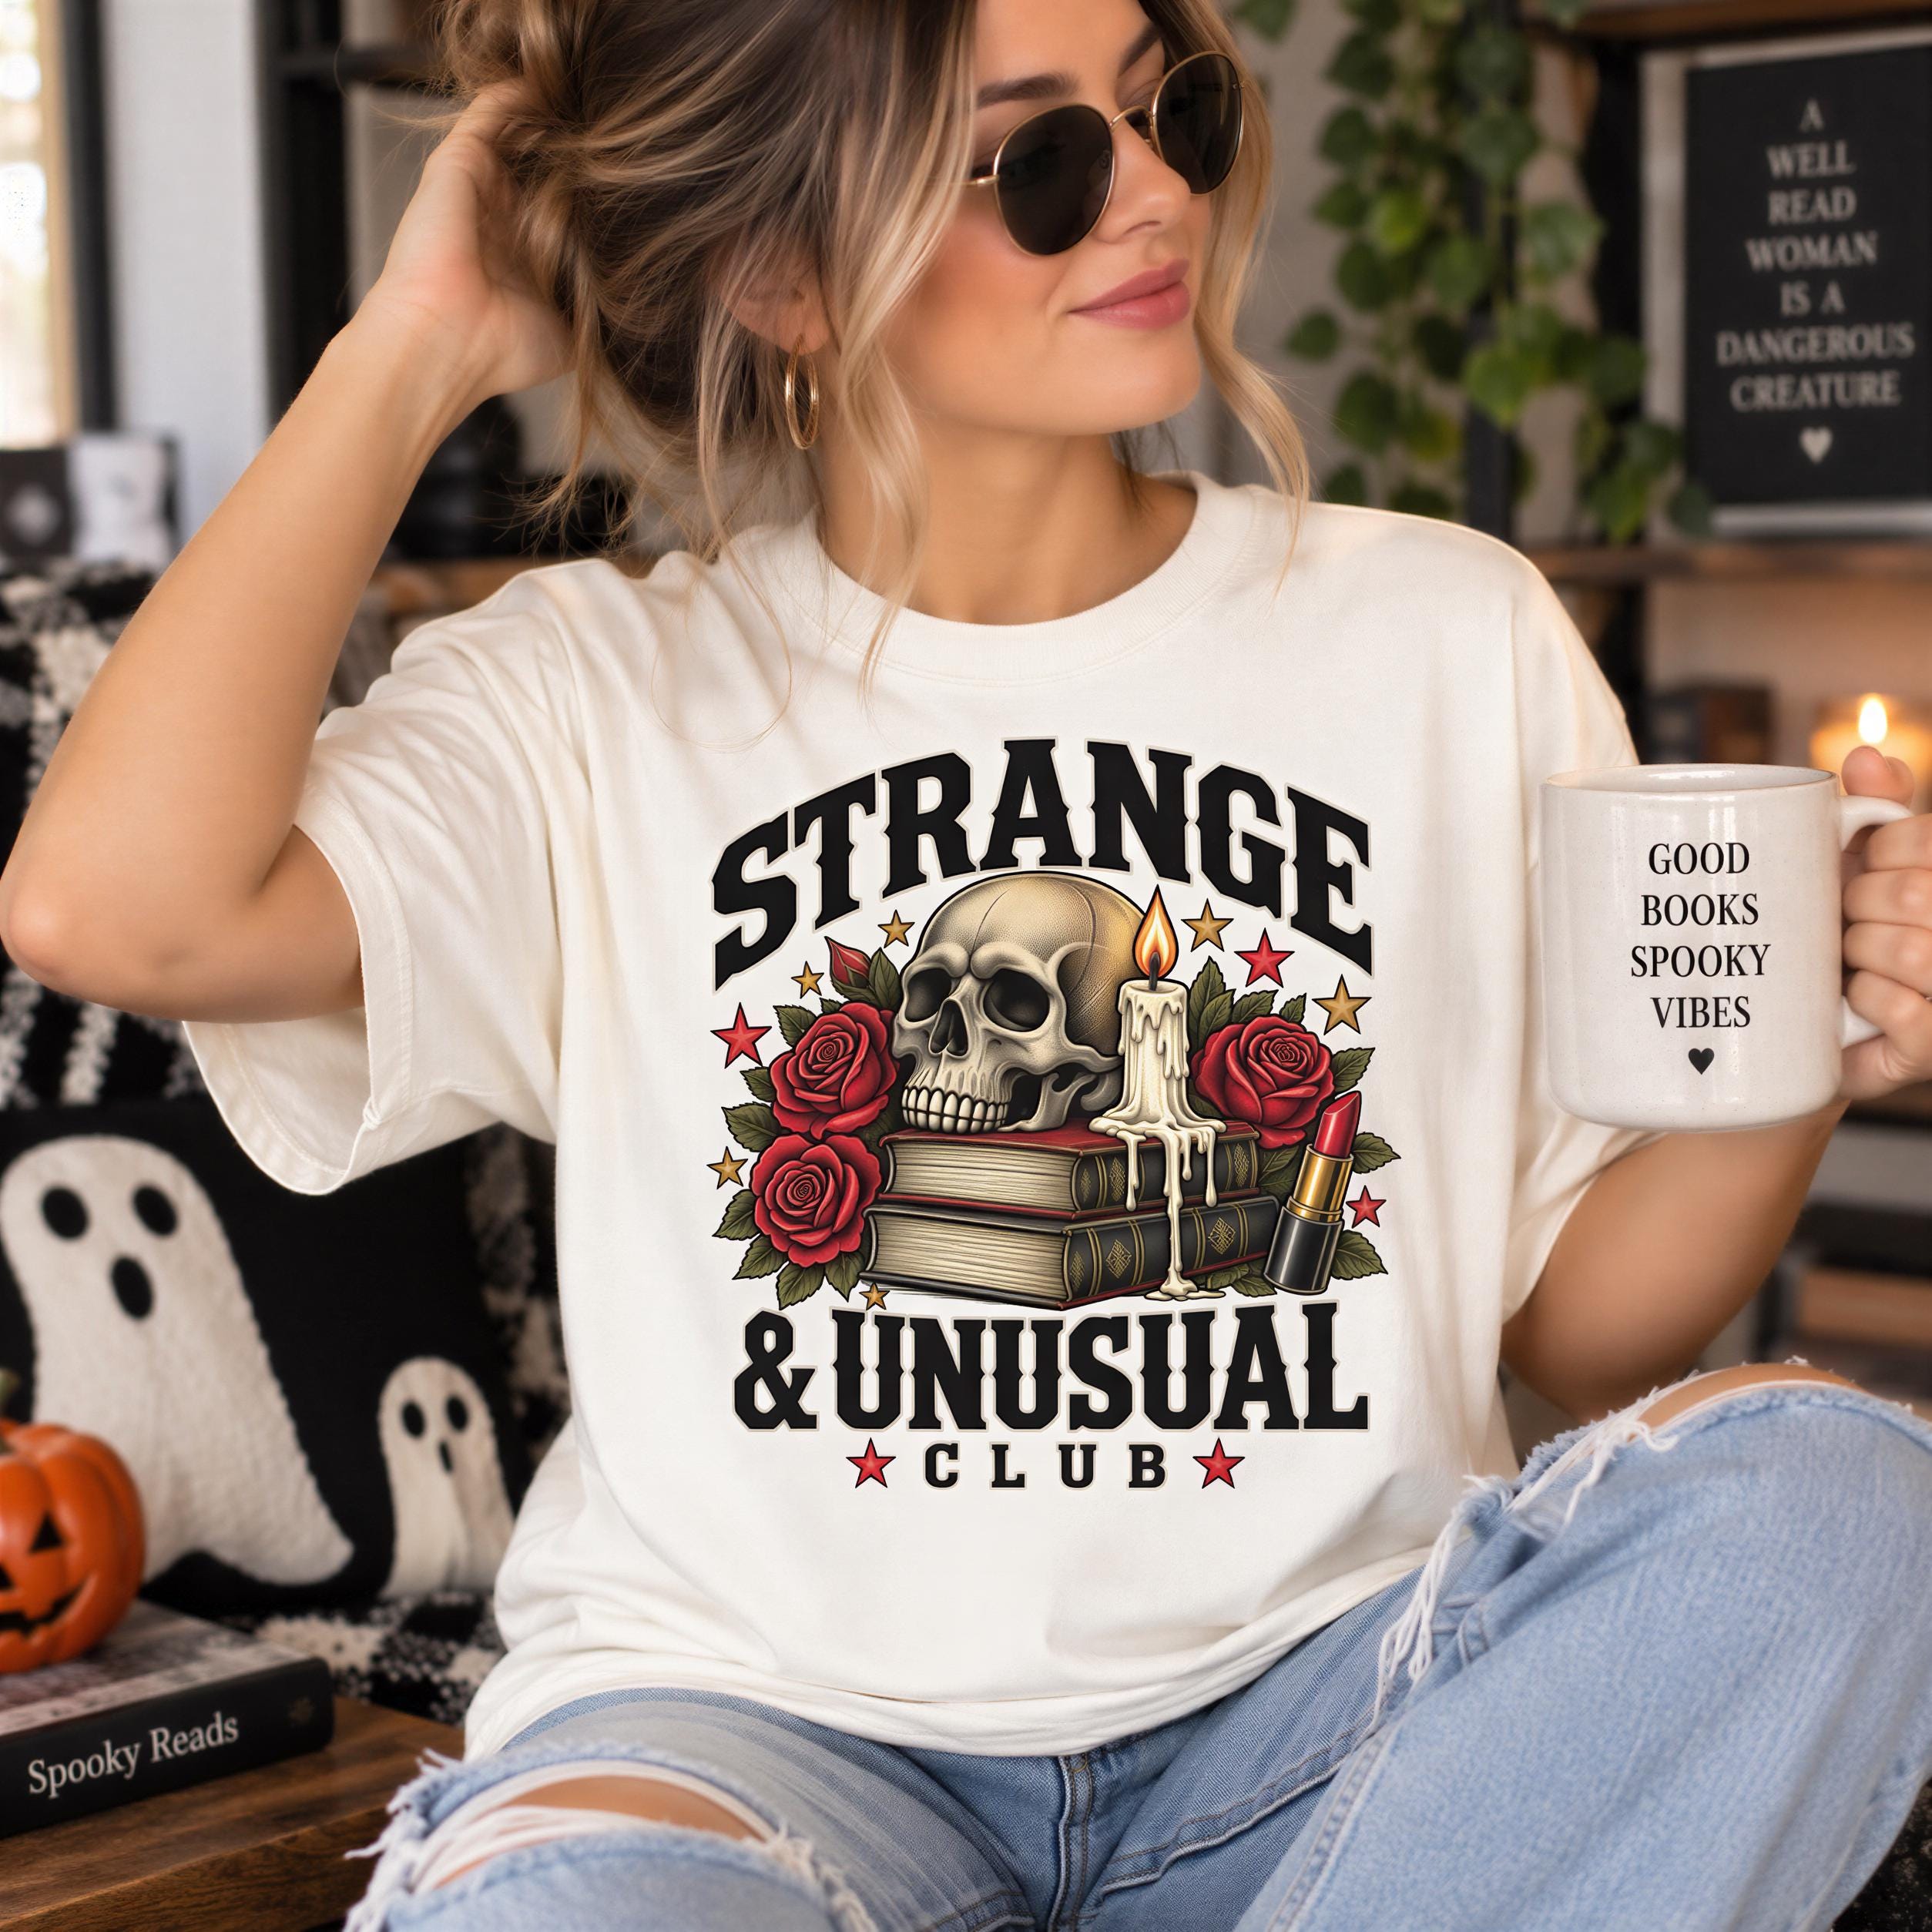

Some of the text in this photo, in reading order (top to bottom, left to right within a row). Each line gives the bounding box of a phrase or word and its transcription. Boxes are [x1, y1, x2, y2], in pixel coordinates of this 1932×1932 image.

[1801, 100, 1823, 131] A
[1767, 140, 1855, 179] WELL
[1768, 186, 1857, 225] READ
[1746, 230, 1877, 271] WOMAN
[1781, 281, 1845, 316] IS A
[1716, 322, 1915, 366] DANGEROUS
[1730, 370, 1900, 411] CREATURE
[710, 738, 1374, 992] STRANGE
[1649, 842, 1750, 875] GOOD
[1641, 893, 1759, 926] BOOKS
[1631, 944, 1771, 978] SPOOKY
[1650, 996, 1751, 1028] VIBES
[733, 1303, 1369, 1431] & UNUSUAL
[924, 1442, 1166, 1489] CLUB
[29, 1712, 238, 1798] Spooky Reads
